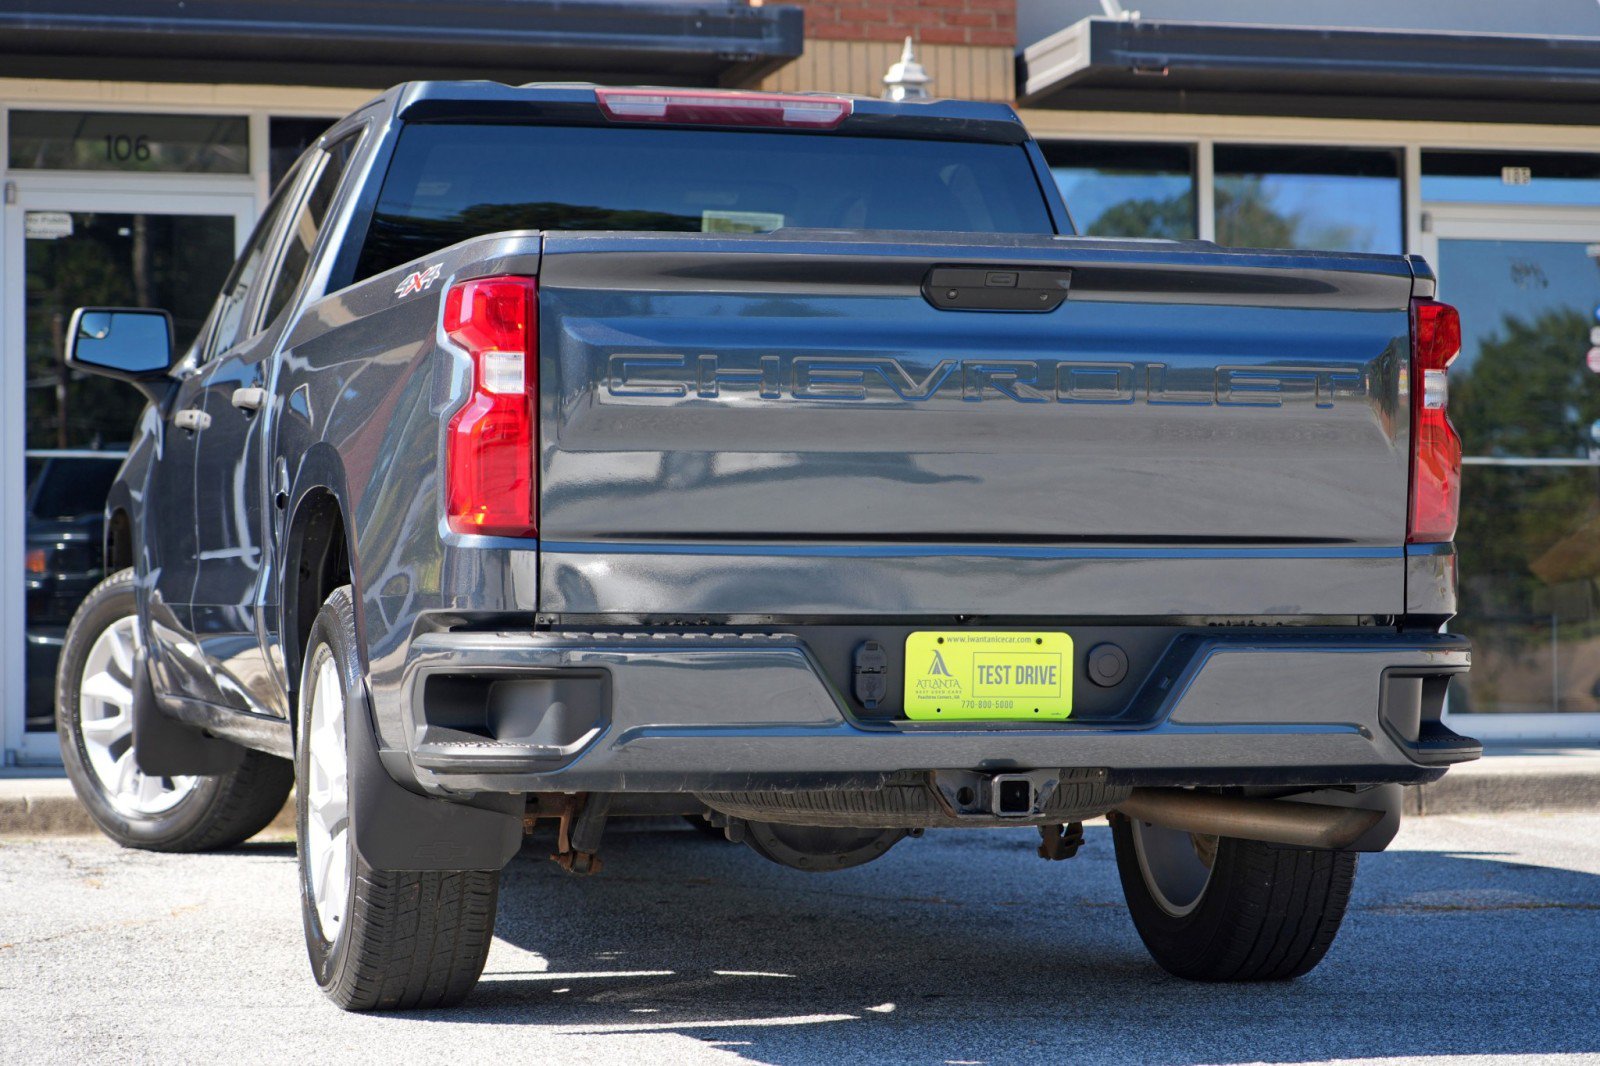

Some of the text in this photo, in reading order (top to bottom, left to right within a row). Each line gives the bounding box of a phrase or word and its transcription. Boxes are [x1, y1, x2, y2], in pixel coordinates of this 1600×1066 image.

[105, 134, 151, 162] 106
[608, 353, 1363, 409] CHEVROLET
[946, 635, 1032, 644] www.iwantanicecar.com
[977, 665, 1057, 685] TEST DRIVE
[915, 679, 963, 690] ATLANTA
[961, 700, 1014, 709] 770-800-5000
